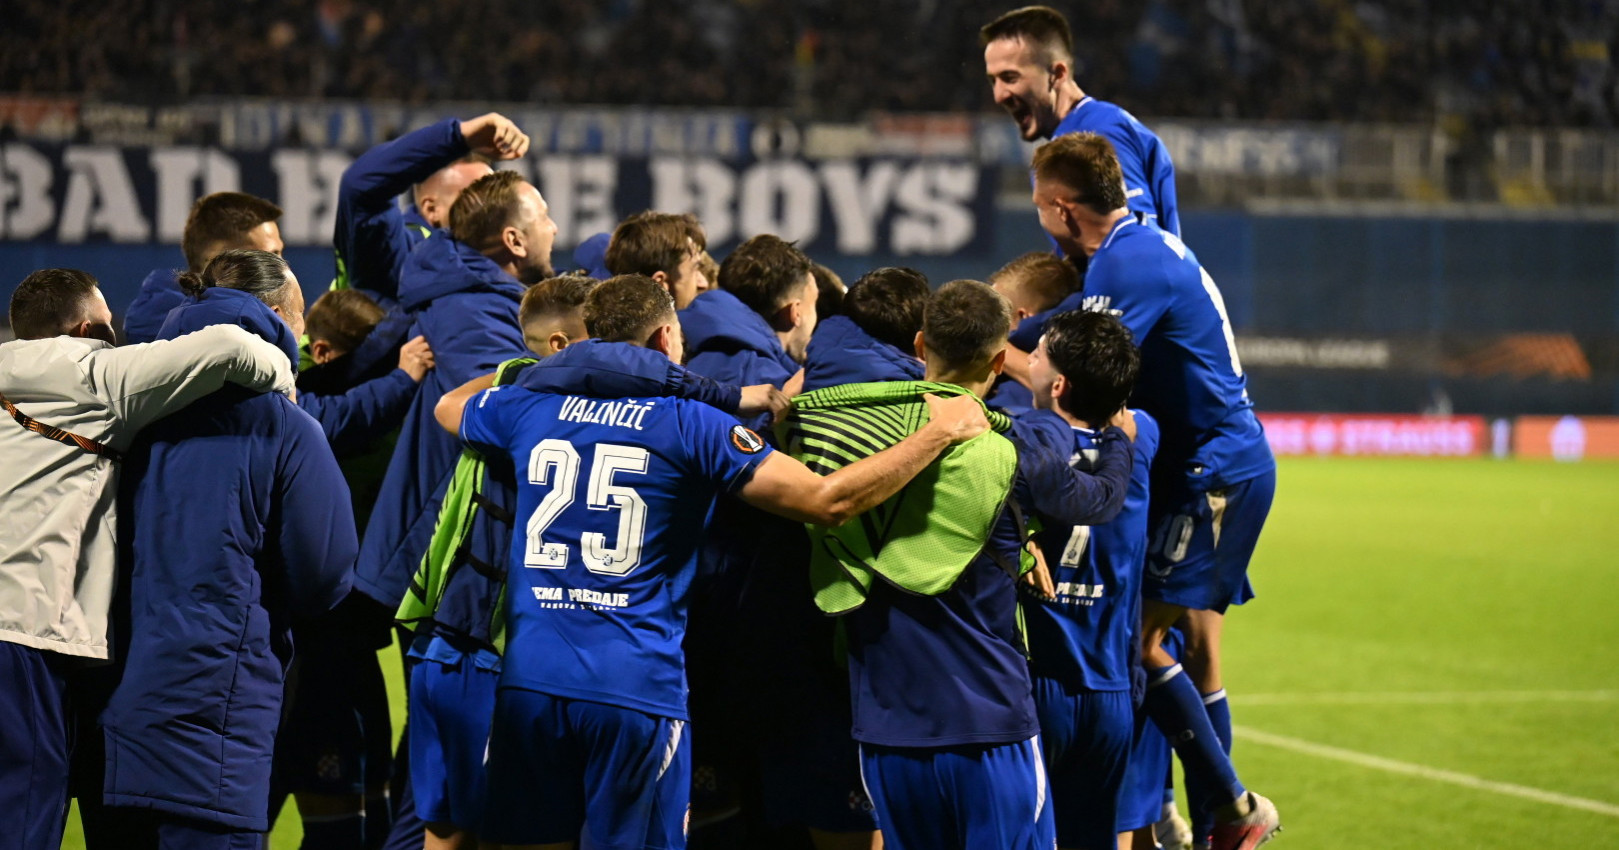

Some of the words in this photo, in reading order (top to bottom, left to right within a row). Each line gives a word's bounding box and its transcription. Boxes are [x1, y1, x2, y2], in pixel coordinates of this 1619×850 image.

[649, 156, 978, 256] BOYS
[558, 395, 655, 431] VALINČIĆ
[524, 438, 650, 577] 25
[531, 586, 563, 600] EMA
[568, 588, 629, 607] PREDAJE
